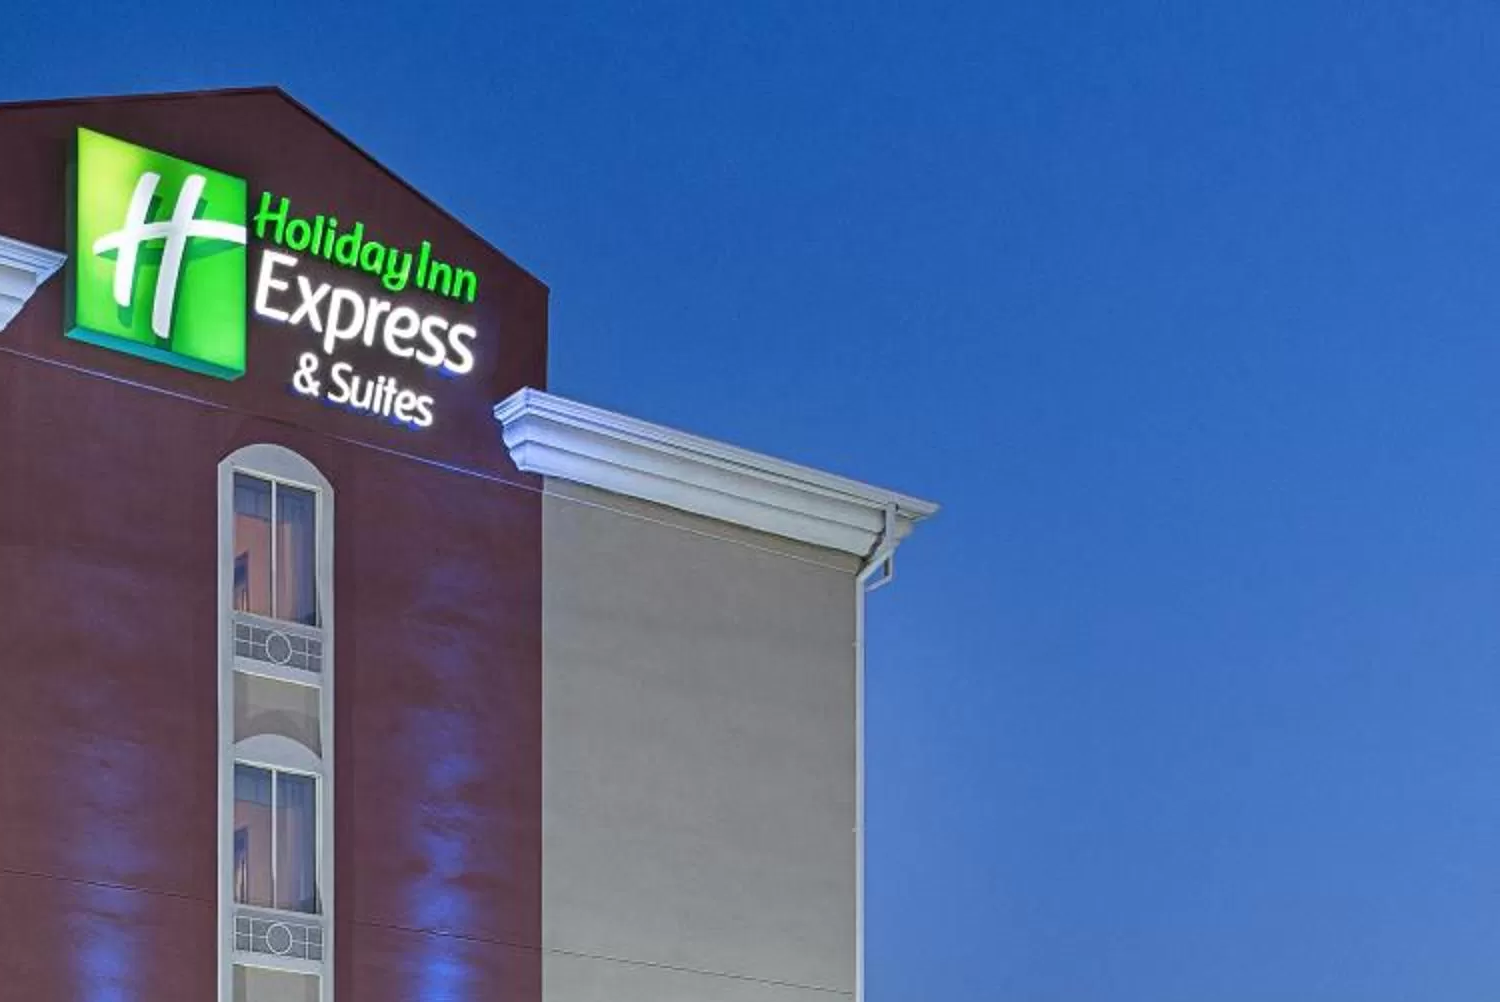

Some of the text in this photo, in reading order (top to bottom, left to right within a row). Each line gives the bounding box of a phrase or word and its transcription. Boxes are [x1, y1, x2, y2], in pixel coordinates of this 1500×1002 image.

[254, 191, 478, 302] Holiday Inn
[255, 250, 477, 374] Express
[292, 353, 435, 427] & Suites
